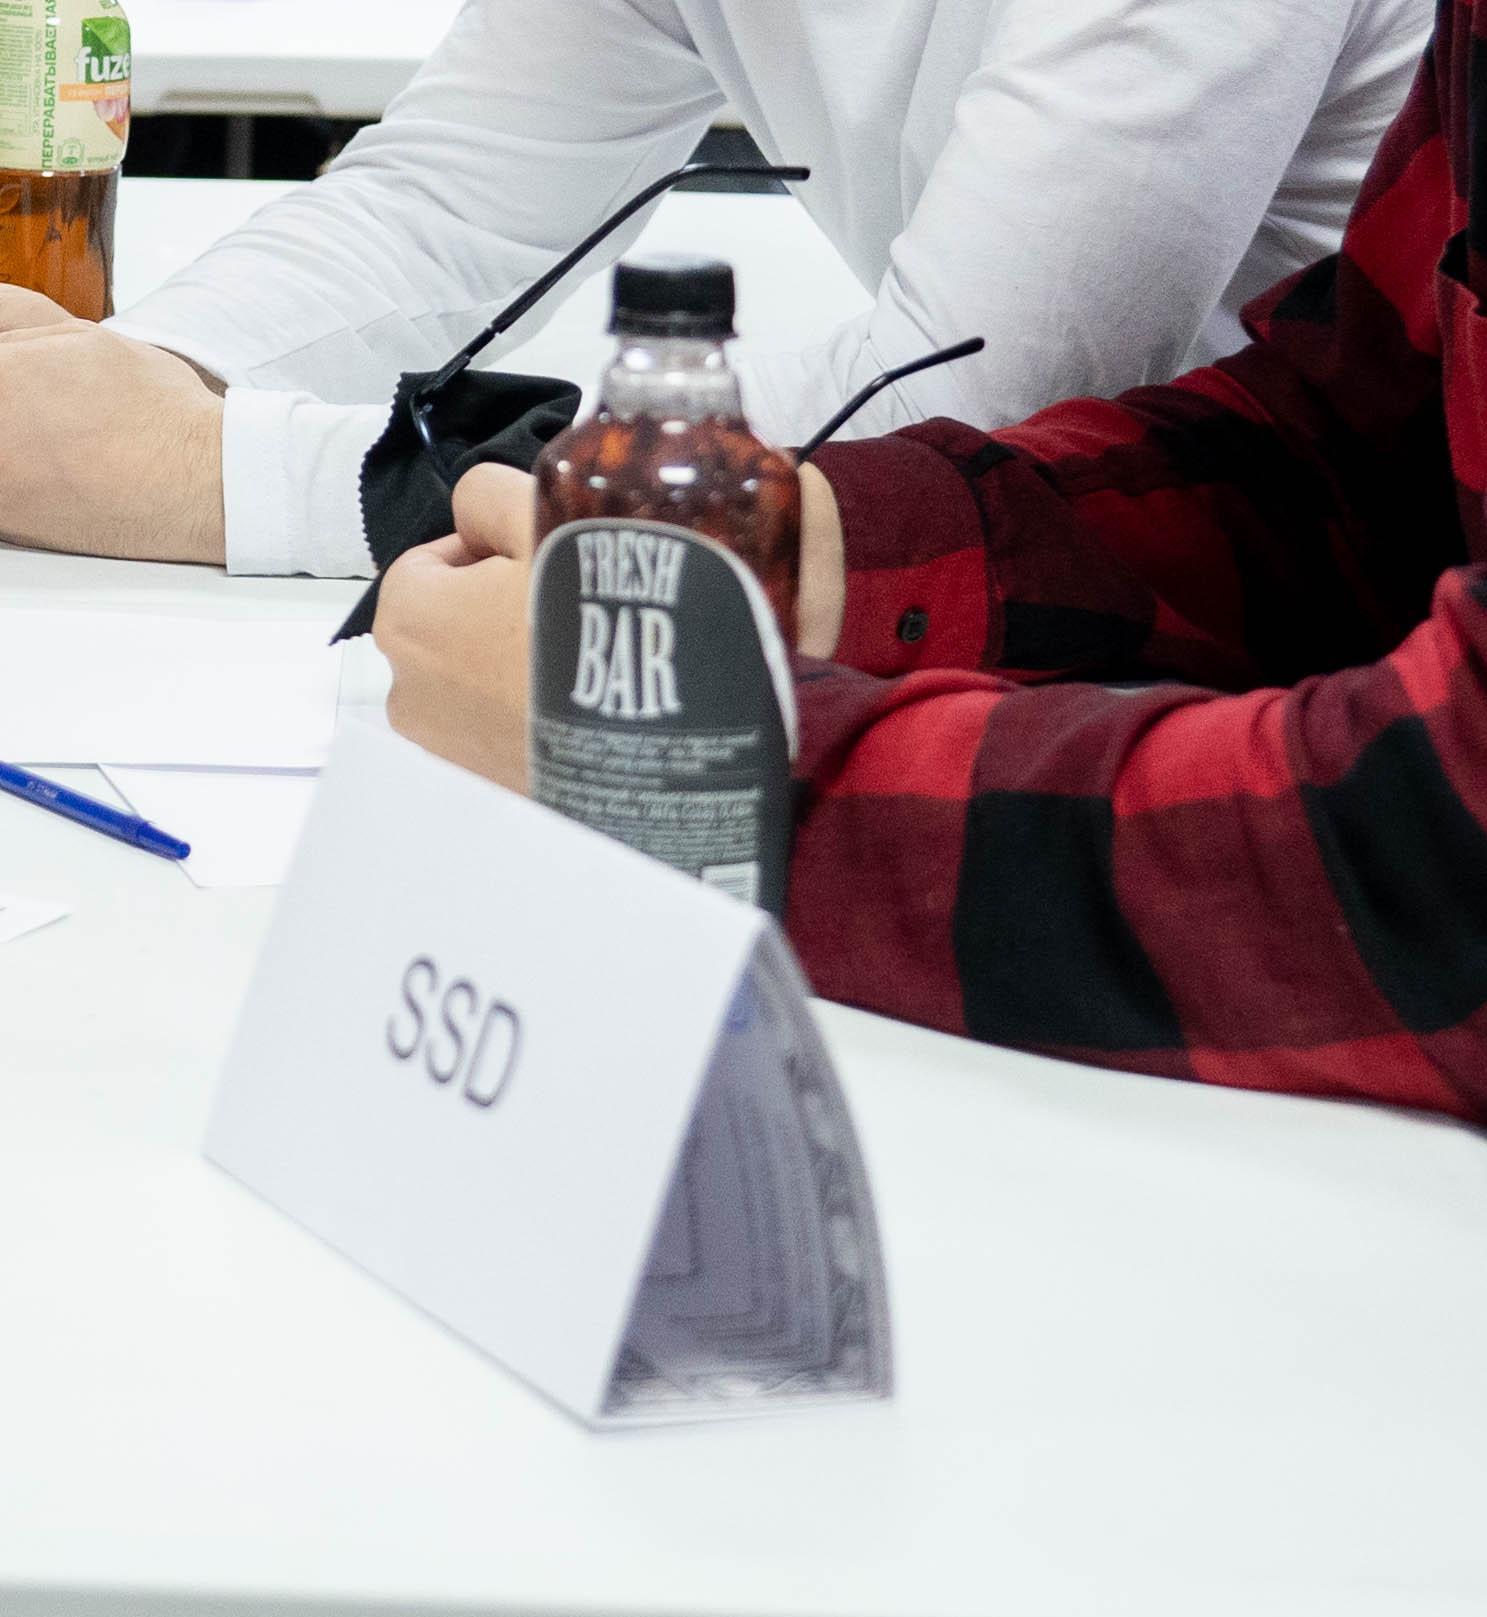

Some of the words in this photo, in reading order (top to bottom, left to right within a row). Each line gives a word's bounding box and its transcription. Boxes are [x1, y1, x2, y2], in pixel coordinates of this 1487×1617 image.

[576, 530, 687, 606] FRESH
[570, 601, 682, 719] BAR
[386, 953, 521, 1108] SSD
